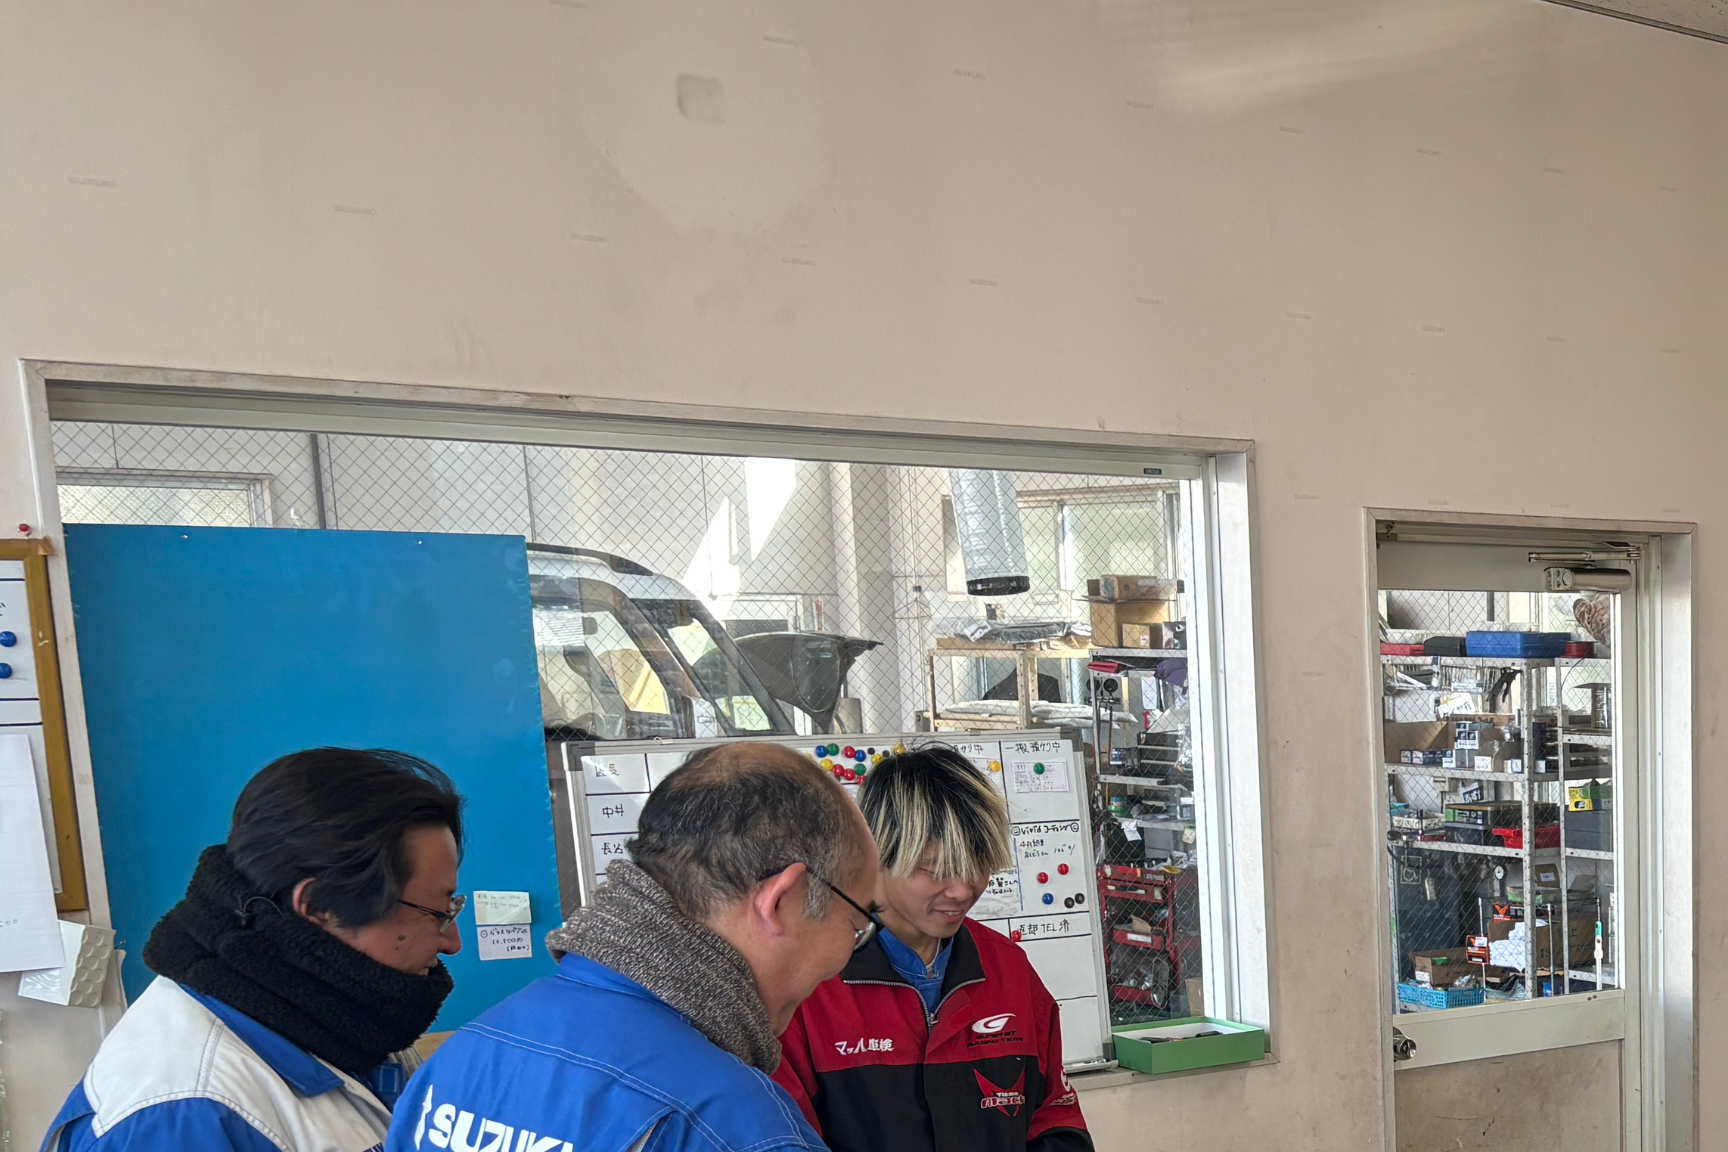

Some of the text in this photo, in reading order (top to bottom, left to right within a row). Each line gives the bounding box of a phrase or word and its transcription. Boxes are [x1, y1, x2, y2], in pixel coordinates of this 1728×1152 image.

[835, 1037, 895, 1055] マッハ車検
